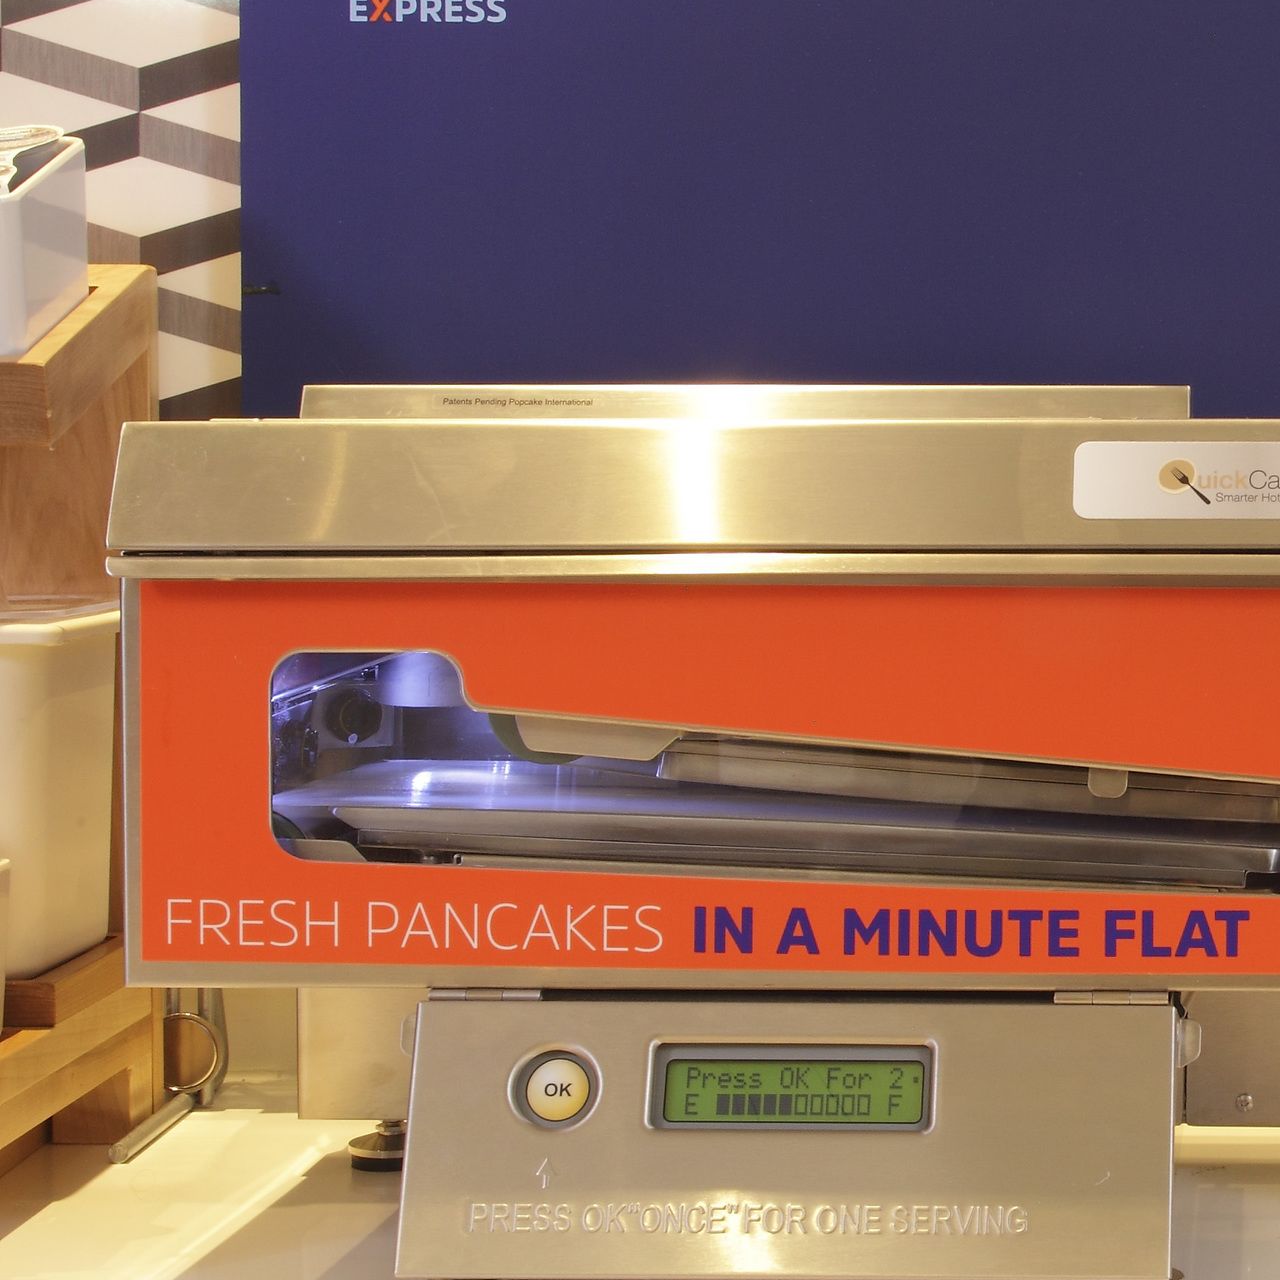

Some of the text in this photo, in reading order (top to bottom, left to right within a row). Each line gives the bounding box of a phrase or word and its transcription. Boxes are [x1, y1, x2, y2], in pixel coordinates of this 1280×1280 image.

[442, 397, 473, 406] Patents
[474, 397, 507, 407] Pending
[544, 398, 594, 407] International
[1215, 492, 1257, 504] Smarter
[1261, 492, 1280, 503] Hot
[165, 898, 1251, 958] FRESH PANCAKES IN A MINUTE FLAT
[686, 1066, 904, 1090] Press OK For 2
[544, 1082, 572, 1098] OK
[467, 1202, 572, 1234] PRESS
[742, 1202, 807, 1235] FOR
[812, 1204, 882, 1235] ONE
[891, 1204, 1029, 1235] SERVING
